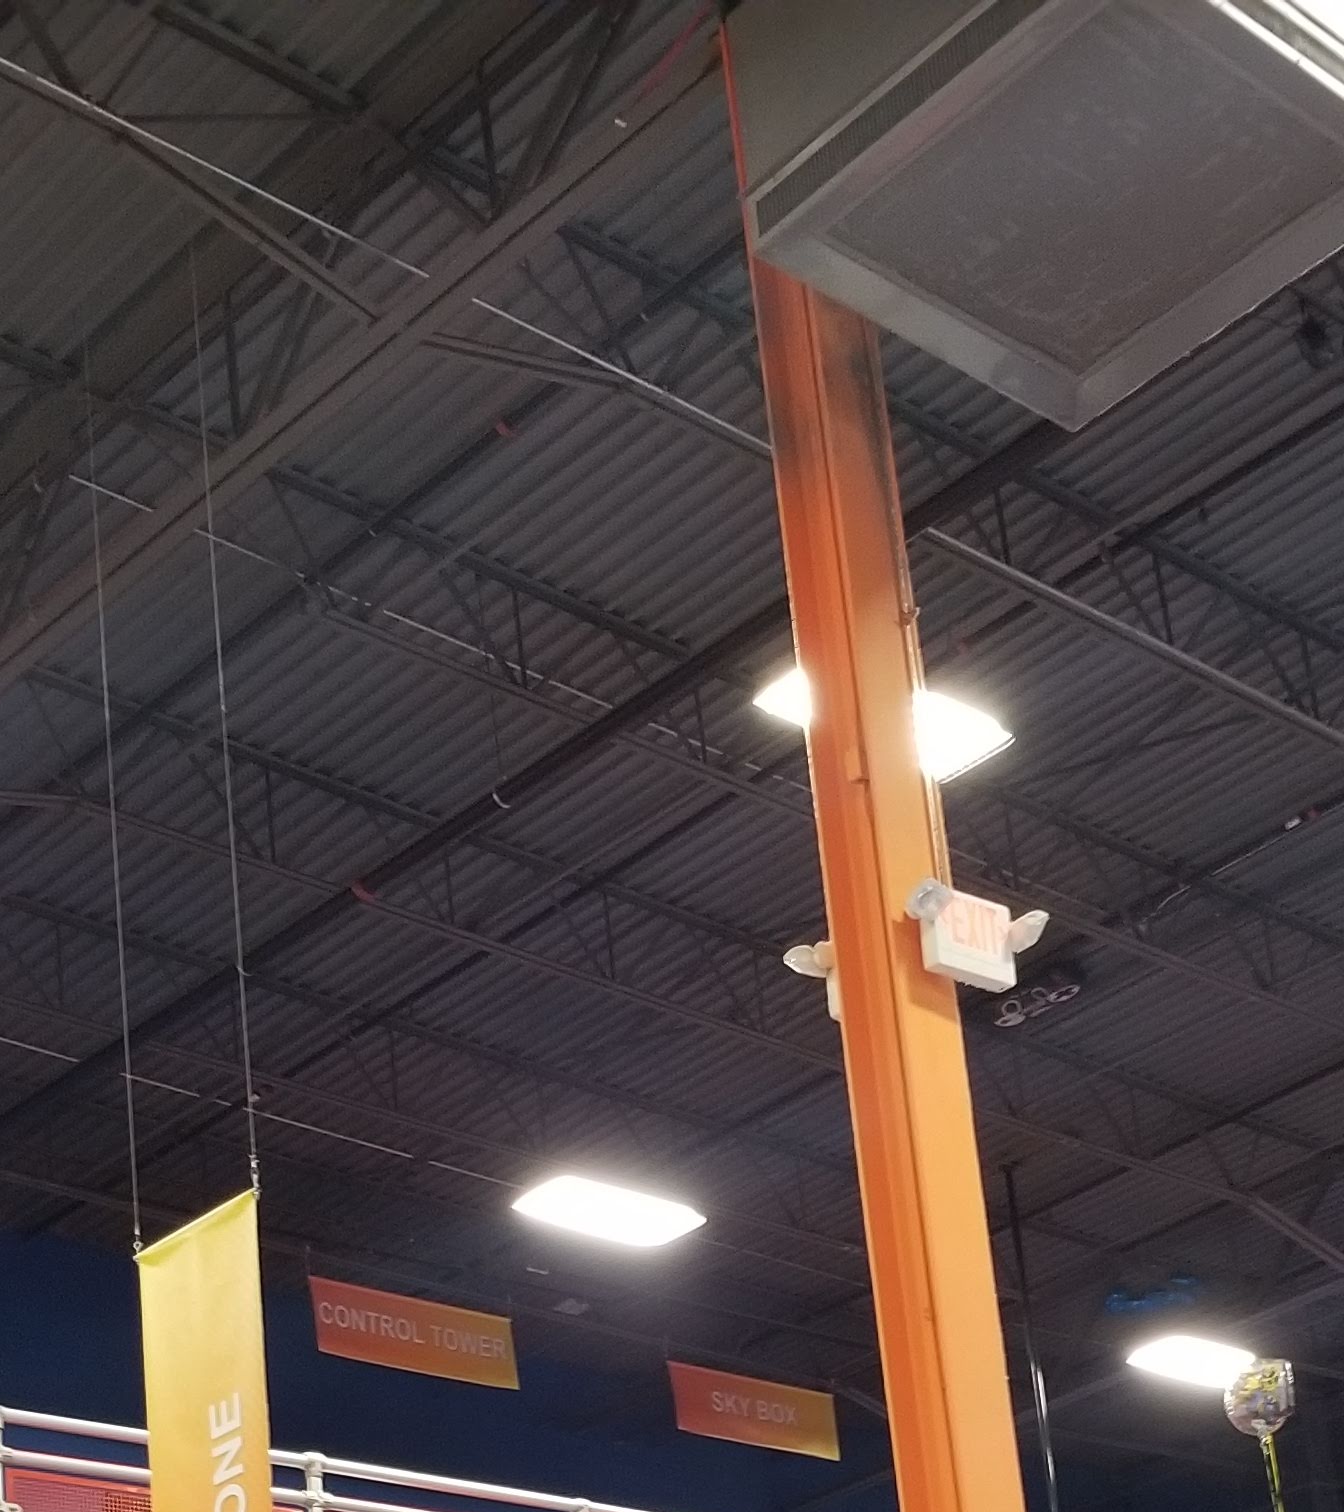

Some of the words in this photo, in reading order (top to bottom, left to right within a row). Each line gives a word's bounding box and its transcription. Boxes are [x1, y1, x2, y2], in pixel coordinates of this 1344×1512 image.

[318, 1301, 425, 1345] CONTROL
[431, 1325, 508, 1361] TOWER
[711, 1391, 755, 1419] SKY
[757, 1398, 798, 1427] BOX
